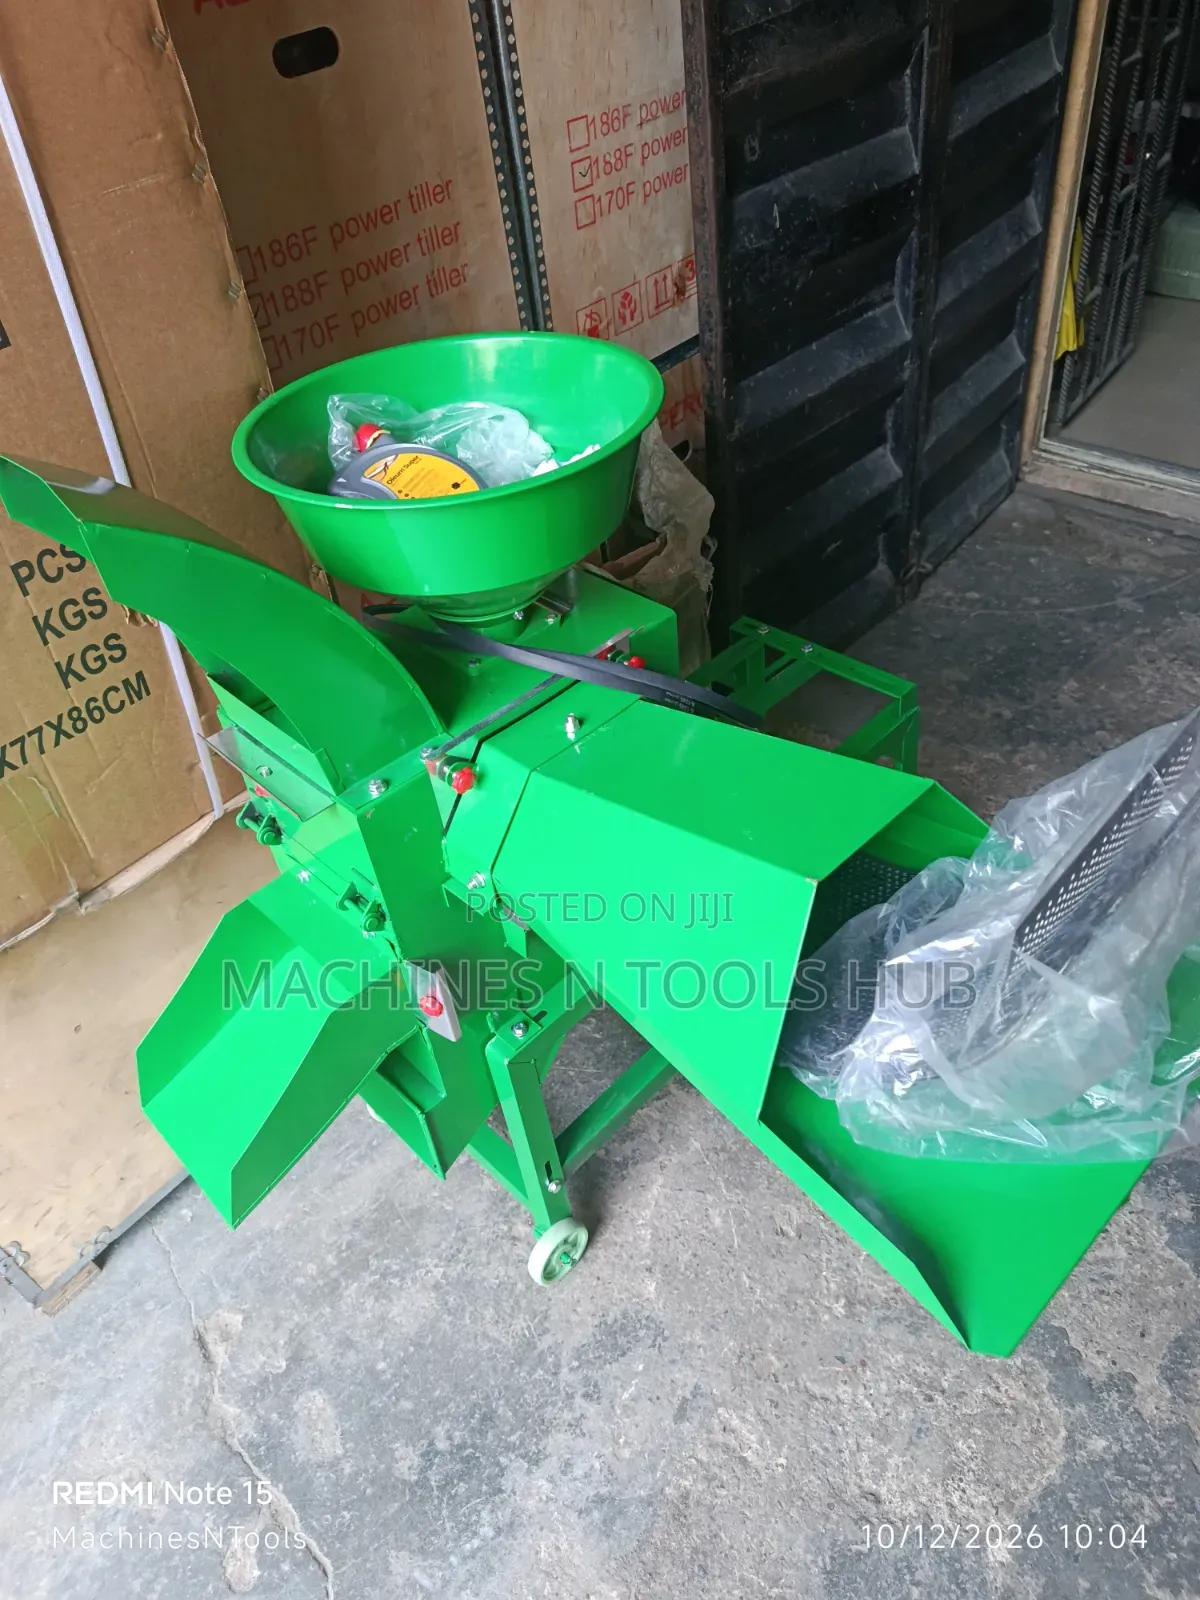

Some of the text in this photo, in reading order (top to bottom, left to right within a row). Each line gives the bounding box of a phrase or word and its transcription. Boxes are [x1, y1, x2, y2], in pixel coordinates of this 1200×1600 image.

[589, 89, 687, 140] 186F power
[592, 126, 688, 179] 188F power
[596, 163, 689, 218] 170F power
[253, 179, 453, 274] 186F power tiller
[266, 221, 461, 318] 188F power tiller
[278, 263, 469, 361] 170F power tiller
[10, 543, 87, 598] PCS
[32, 587, 108, 647] KGS
[54, 632, 128, 690] KGS
